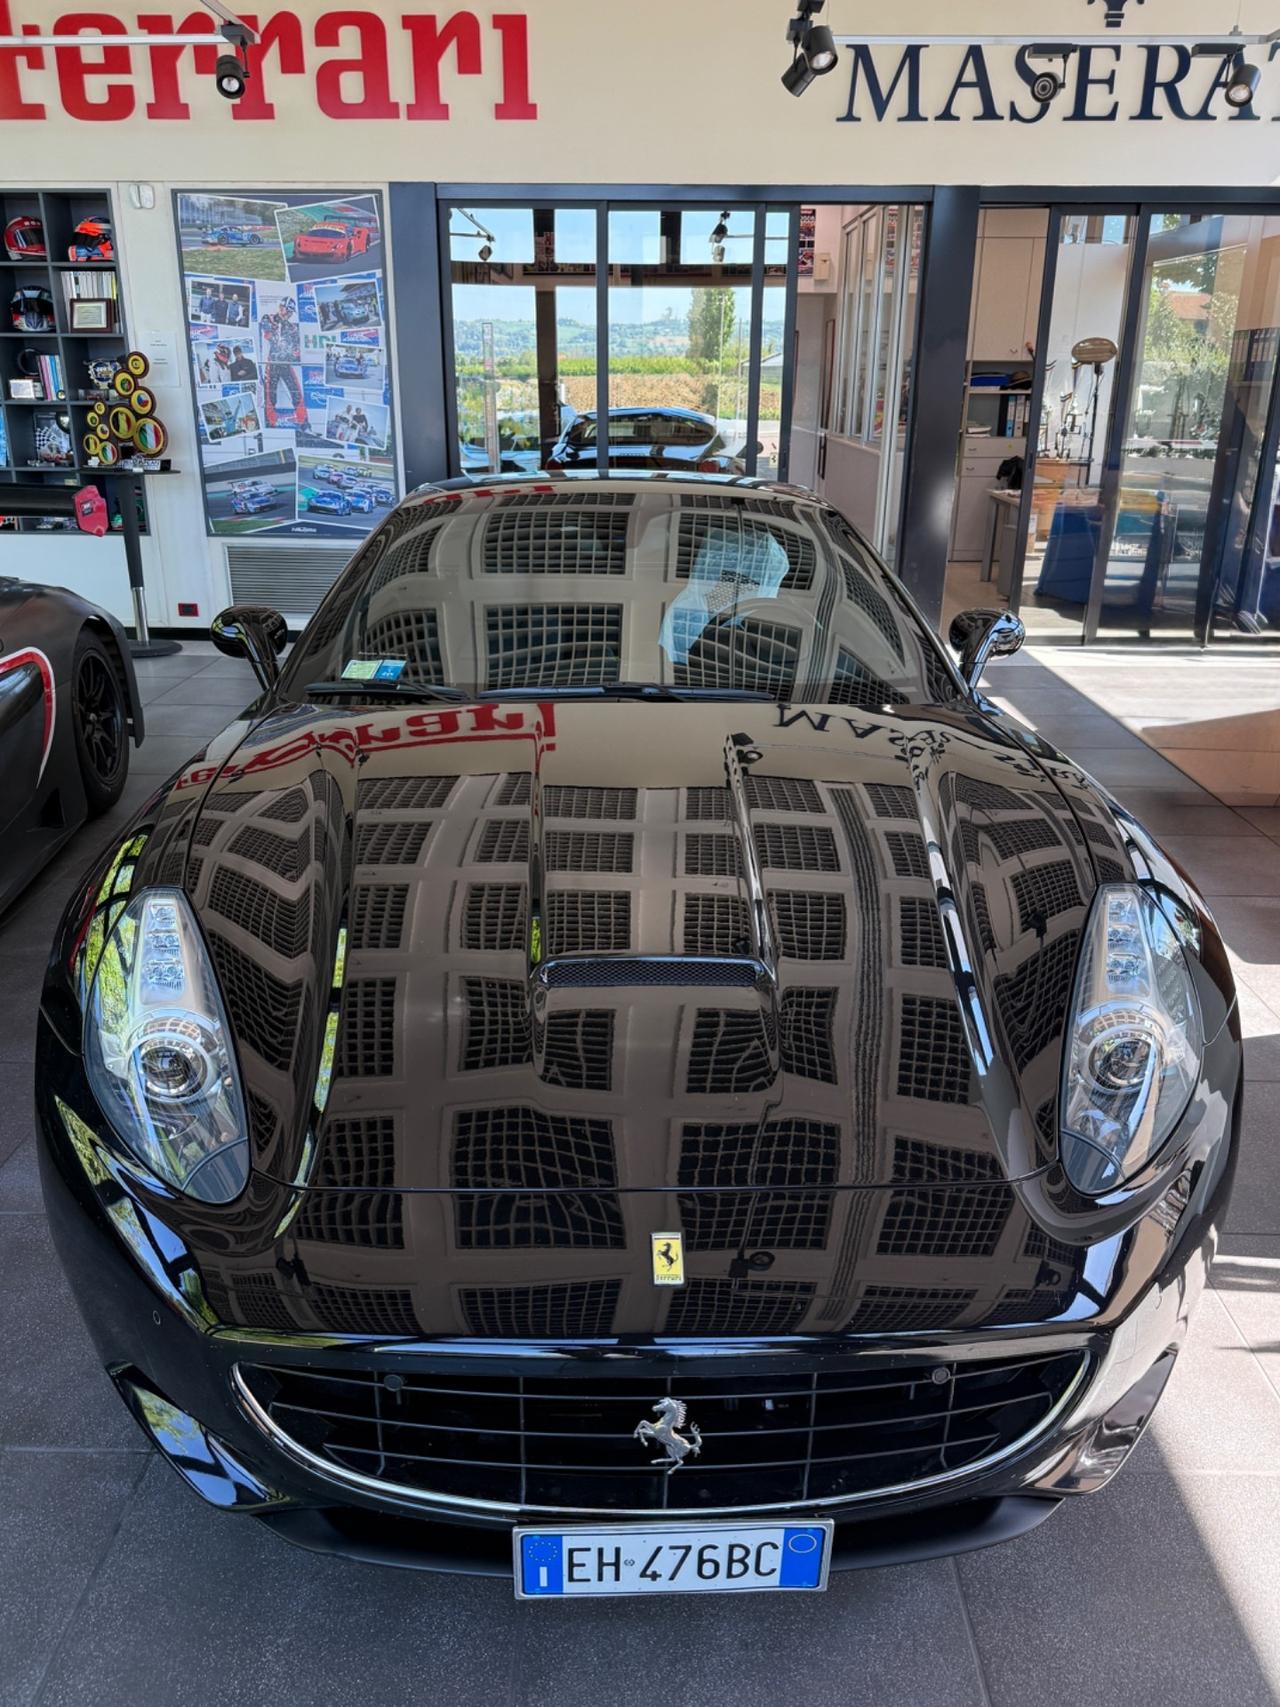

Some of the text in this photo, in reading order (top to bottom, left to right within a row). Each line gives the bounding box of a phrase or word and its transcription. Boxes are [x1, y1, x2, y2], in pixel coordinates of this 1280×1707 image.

[836, 43, 1280, 124] MASERA
[539, 1566, 548, 1587] I
[567, 1541, 779, 1583] EH 476BC
